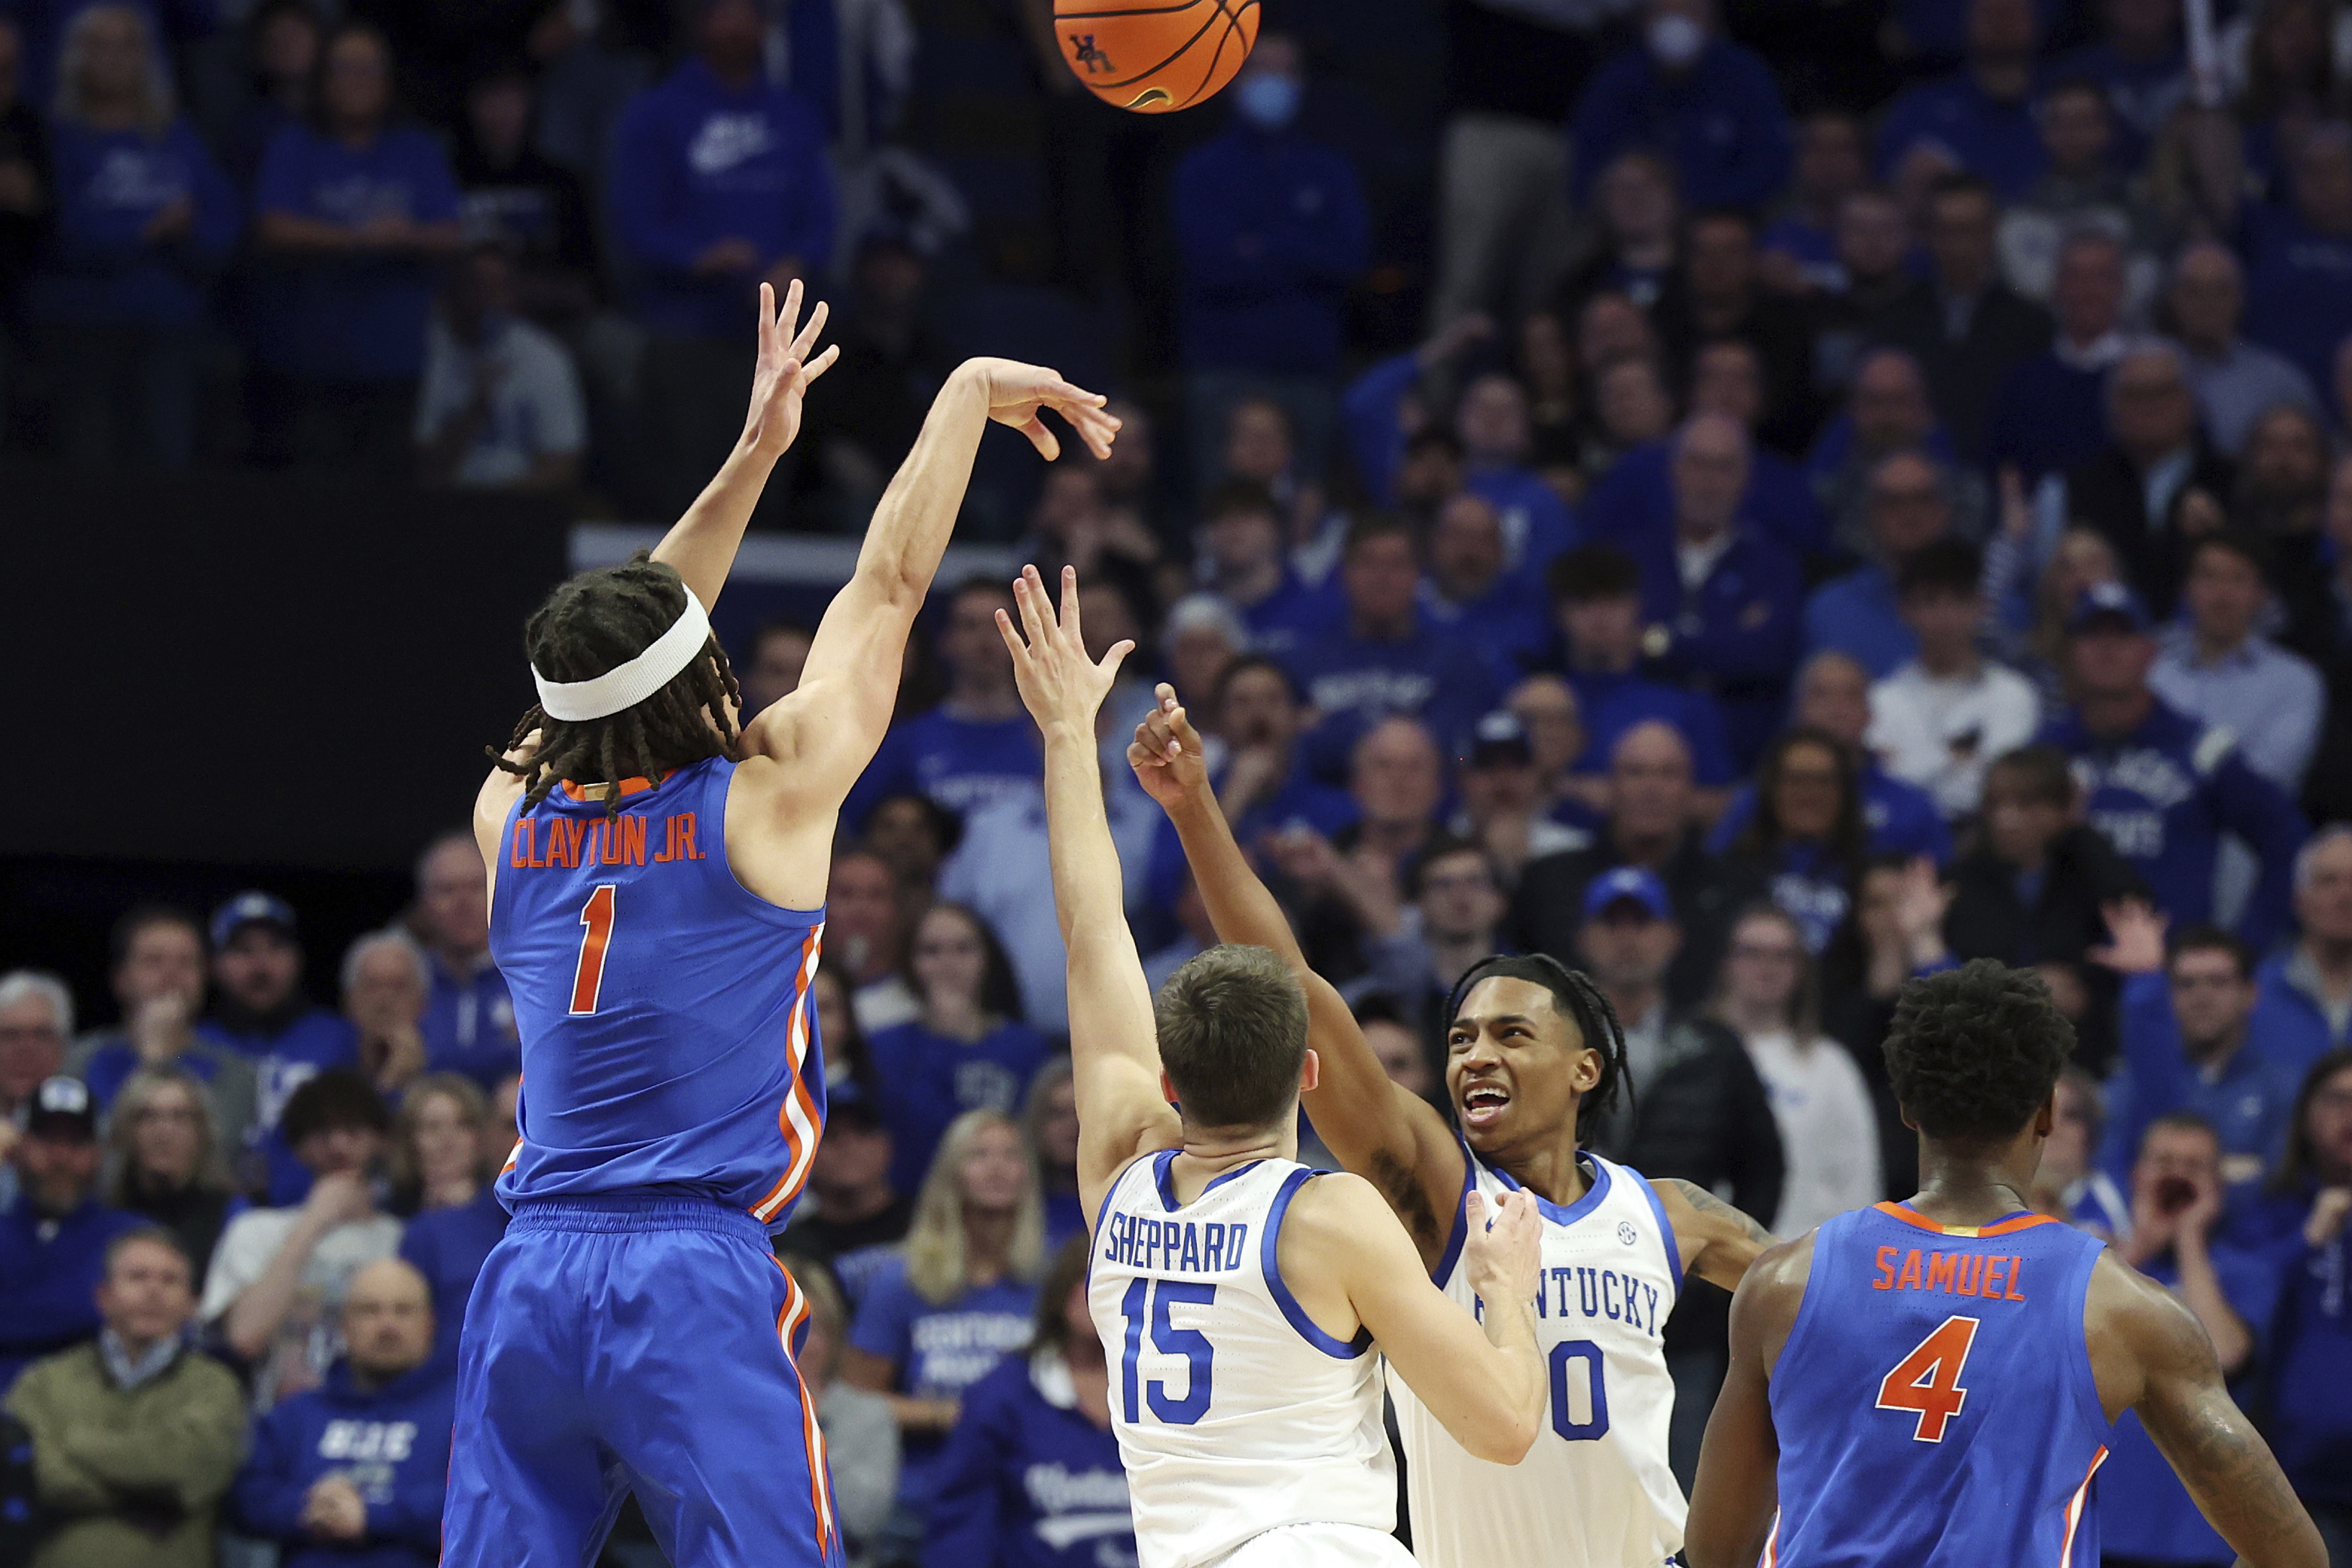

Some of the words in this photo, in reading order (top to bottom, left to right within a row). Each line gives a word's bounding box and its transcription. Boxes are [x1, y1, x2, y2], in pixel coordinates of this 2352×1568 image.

[511, 814, 647, 868] CLAYTON
[654, 811, 706, 863] JR.
[569, 884, 617, 1015] 1
[1105, 1211, 1248, 1273] SHEPPARD
[1872, 1245, 2026, 1301] SAMUEL
[1121, 1277, 1217, 1425] 15
[1549, 1340, 1609, 1441] 0
[1875, 1314, 1980, 1443] 4
